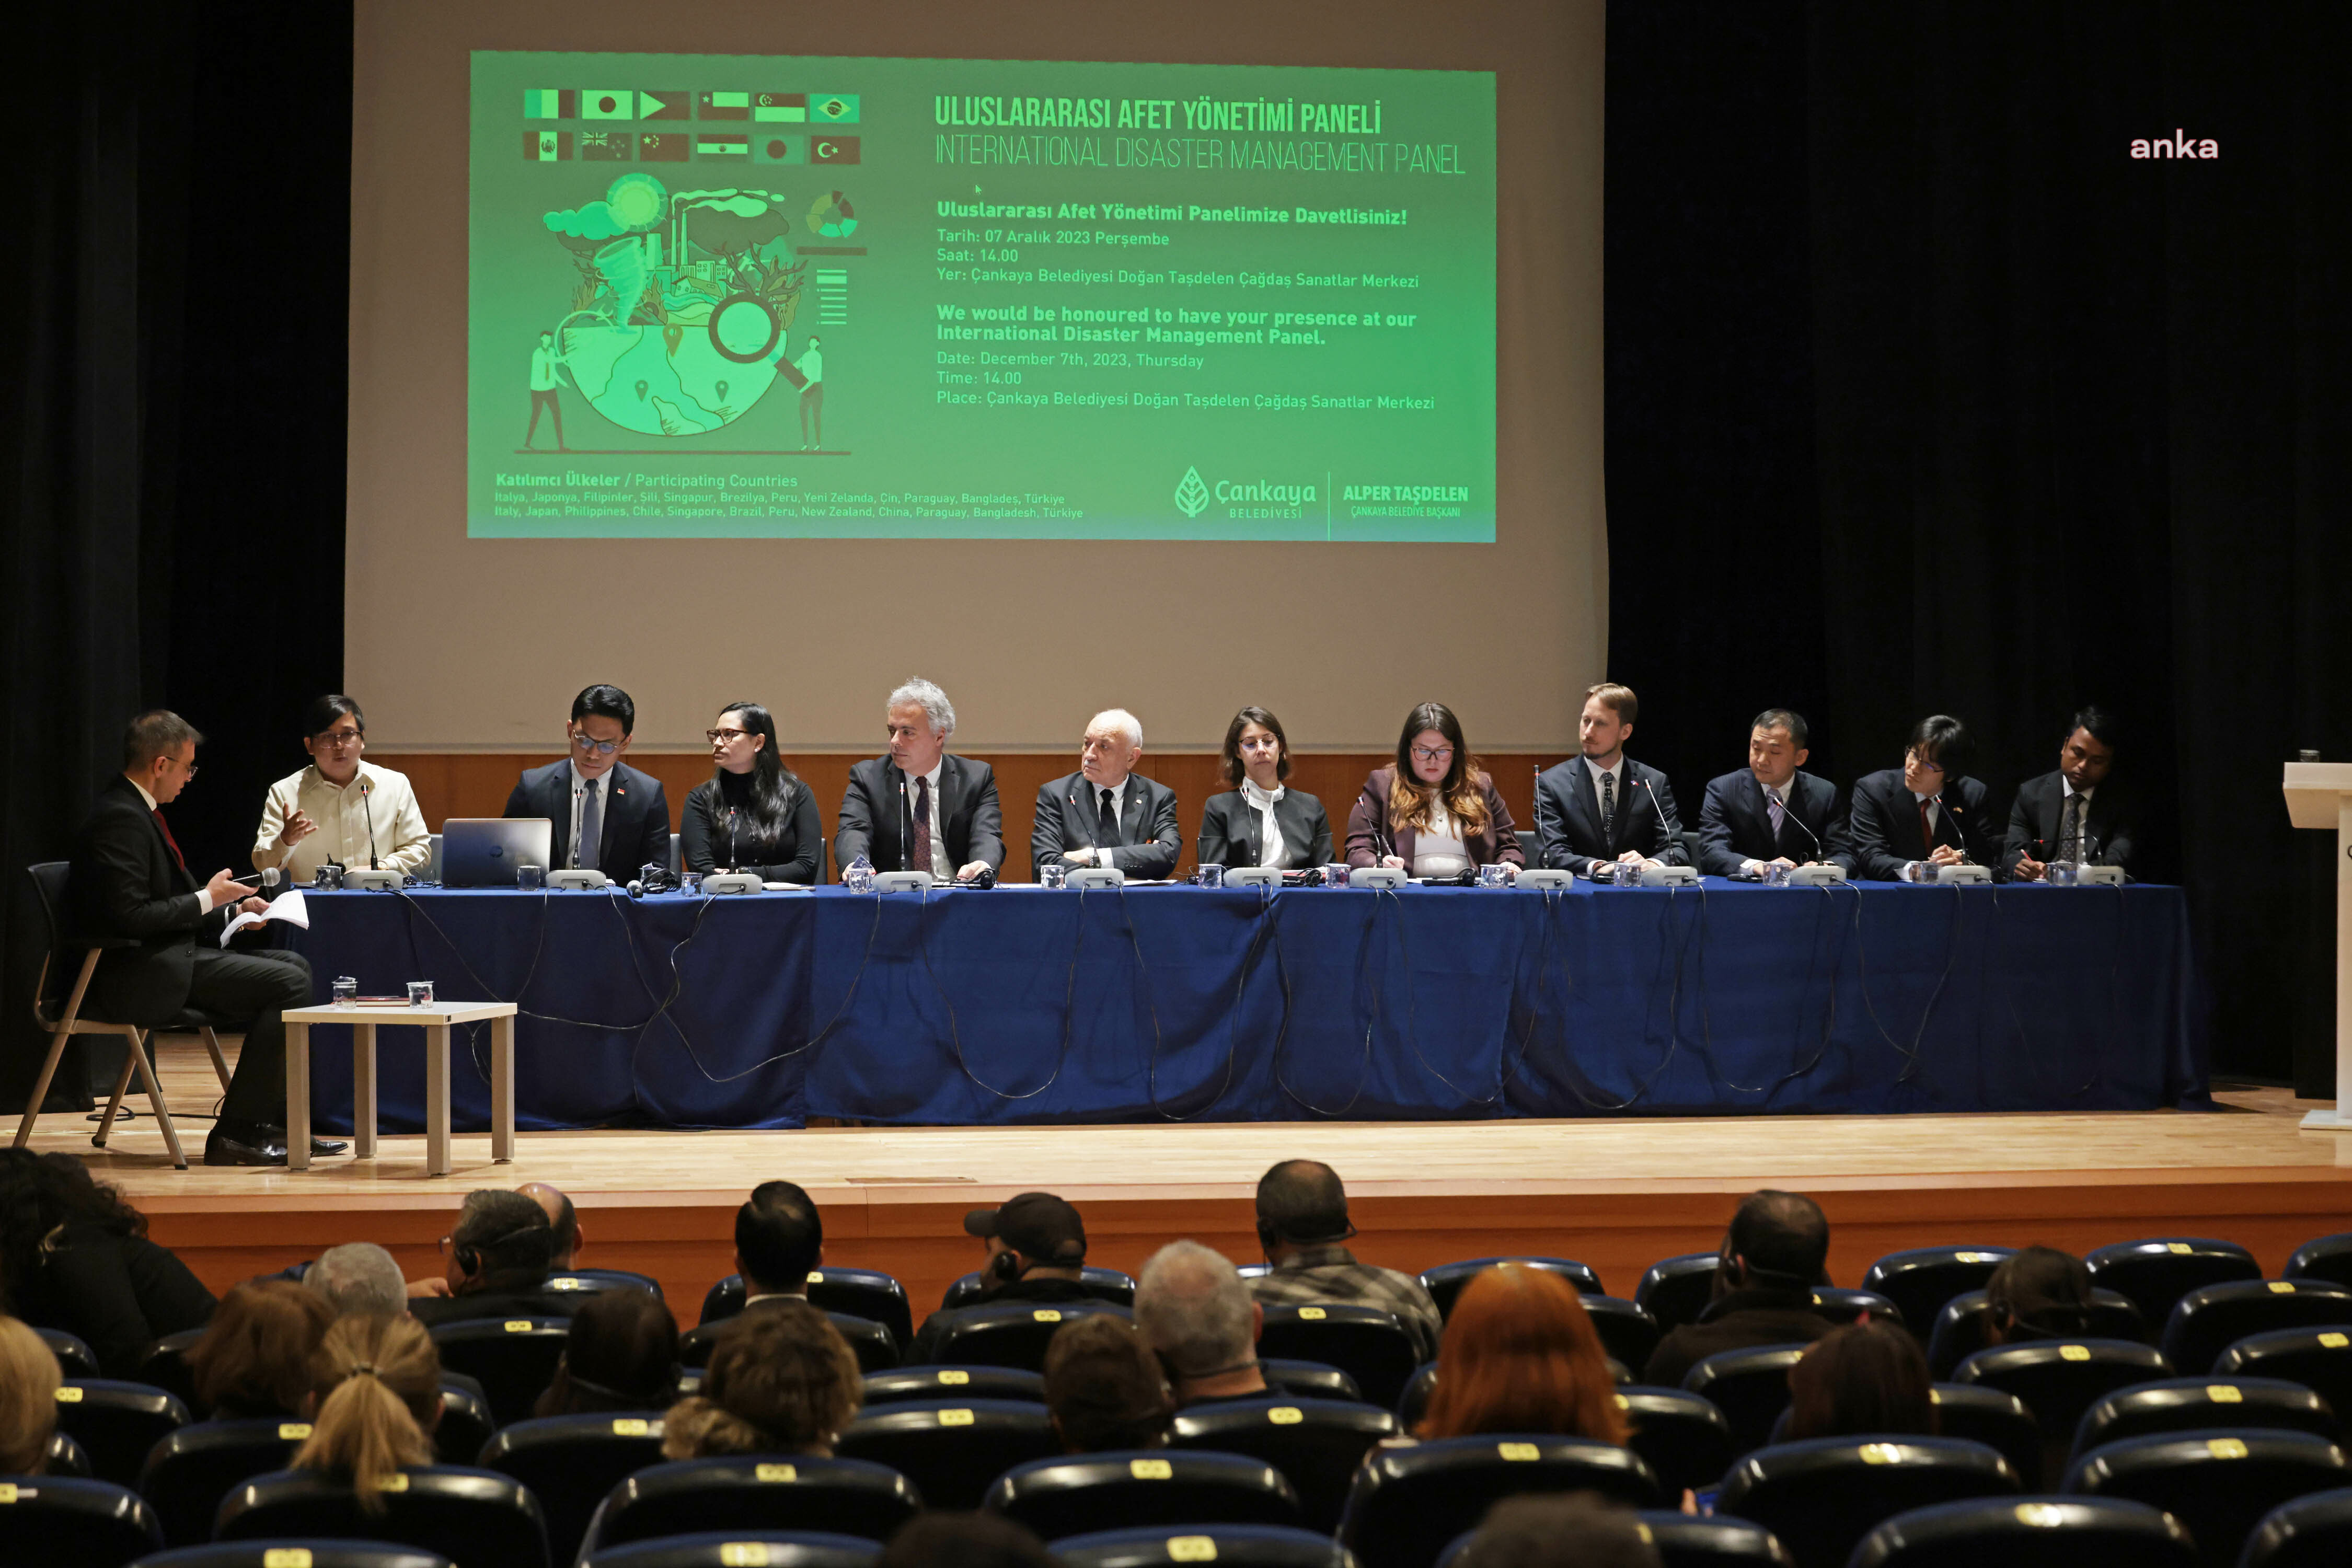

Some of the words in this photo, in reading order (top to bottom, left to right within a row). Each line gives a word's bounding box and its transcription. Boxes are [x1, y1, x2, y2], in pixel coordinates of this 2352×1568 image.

[936, 96, 1110, 128] ULUSLARARASI
[1117, 99, 1175, 129] AFET
[1182, 96, 1293, 132] YÖNETİMİ
[1301, 100, 1380, 134] PANELİ
[937, 134, 1108, 167] INTERNATIONAL
[1115, 137, 1223, 168] DISASTER
[1230, 140, 1388, 172] MANAGEMENT
[1395, 143, 1466, 175] PANEL
[937, 201, 1052, 218] Uluslararası
[1057, 203, 1096, 219] Afet
[1101, 203, 1183, 221] Yönetimi
[1189, 205, 1289, 223] Panelimize
[1295, 207, 1407, 225] Davetlisiniz!
[937, 228, 979, 242] Tarih:
[985, 229, 1002, 243] 07
[1007, 230, 1051, 243] Aralık
[1056, 230, 1090, 244] 2023
[1096, 231, 1169, 248] Perşembe
[937, 248, 974, 261] Saat:
[981, 249, 1018, 262] 14.00
[937, 268, 966, 280] Yer:
[972, 268, 1033, 284] Çankaya
[1039, 269, 1112, 285] Belediyesi
[1119, 270, 1163, 286] Doğan
[1168, 271, 1233, 287] Taşdelen
[1239, 272, 1292, 289] Çağdaş
[1296, 273, 1357, 286] Sanatlar
[1363, 274, 1419, 287] Merkezi
[937, 305, 965, 320] We
[971, 305, 1027, 321] would
[1034, 306, 1055, 321] be
[1062, 306, 1149, 322] honoured
[1155, 308, 1172, 323] to
[1179, 308, 1221, 324] have
[1227, 312, 1269, 327] your
[1275, 313, 1357, 328] presence
[1363, 312, 1381, 326] at
[1386, 315, 1417, 327] our
[938, 324, 1057, 341] International
[1064, 326, 1140, 342] Disaster
[1147, 327, 1263, 346] Management
[1270, 329, 1325, 344] Panel.
[937, 351, 974, 364] Date:
[981, 352, 1055, 365] December
[1060, 352, 1087, 367] 7th,
[1093, 353, 1131, 367] 2023,
[1136, 353, 1204, 370] Thursday
[937, 371, 977, 384] Time:
[984, 372, 1021, 384] 14.00
[937, 391, 982, 403] Place:
[987, 391, 1048, 407] Çankaya
[1054, 392, 1127, 408] Belediyesi
[1134, 393, 1178, 409] Doğan
[1184, 393, 1249, 409] Taşdelen
[1254, 394, 1307, 410] Çağdaş
[1311, 395, 1373, 408] Sanatlar
[1378, 396, 1434, 409] Merkezi
[497, 473, 560, 486] Katılımcı
[566, 470, 621, 486] Ülkeler
[636, 474, 724, 489] Participating
[730, 474, 798, 487] Countries
[495, 490, 528, 504] İtalya,
[532, 492, 580, 504] Japonya,
[584, 491, 637, 504] Filipinler,
[640, 491, 660, 504] Şili,
[664, 492, 716, 504] Singapur,
[721, 492, 767, 504] Brezilya,
[771, 492, 800, 503] Peru,
[804, 492, 827, 502] Yeni
[831, 492, 877, 504] Zelanda,
[881, 492, 901, 505] Çin,
[905, 492, 959, 505] Paraguay,
[962, 493, 1021, 505] Bangladeş,
[1024, 493, 1065, 506] Türkiye
[1215, 479, 1317, 506] Çankaya
[1343, 486, 1391, 501] ALPER
[1393, 486, 1469, 505] TAŞDELEN
[495, 506, 521, 518] Italy,
[525, 506, 561, 518] Japan,
[565, 506, 629, 518] Philippines,
[633, 506, 664, 517] Chile,
[667, 506, 727, 518] Singapore,
[730, 506, 765, 517] Brazil,
[769, 506, 798, 517] Peru,
[802, 506, 826, 516] New
[829, 506, 875, 518] Zealand,
[879, 506, 912, 518] China,
[916, 507, 969, 519] Paraguay,
[974, 507, 1039, 520] Bangladesh,
[1043, 508, 1083, 520] Türkiye
[1230, 506, 1301, 518] BELEDİYESİ
[1351, 506, 1387, 518] ÇANKAYA
[1388, 504, 1424, 517] BELEDİYE
[1427, 506, 1460, 518] BAŞKANI
